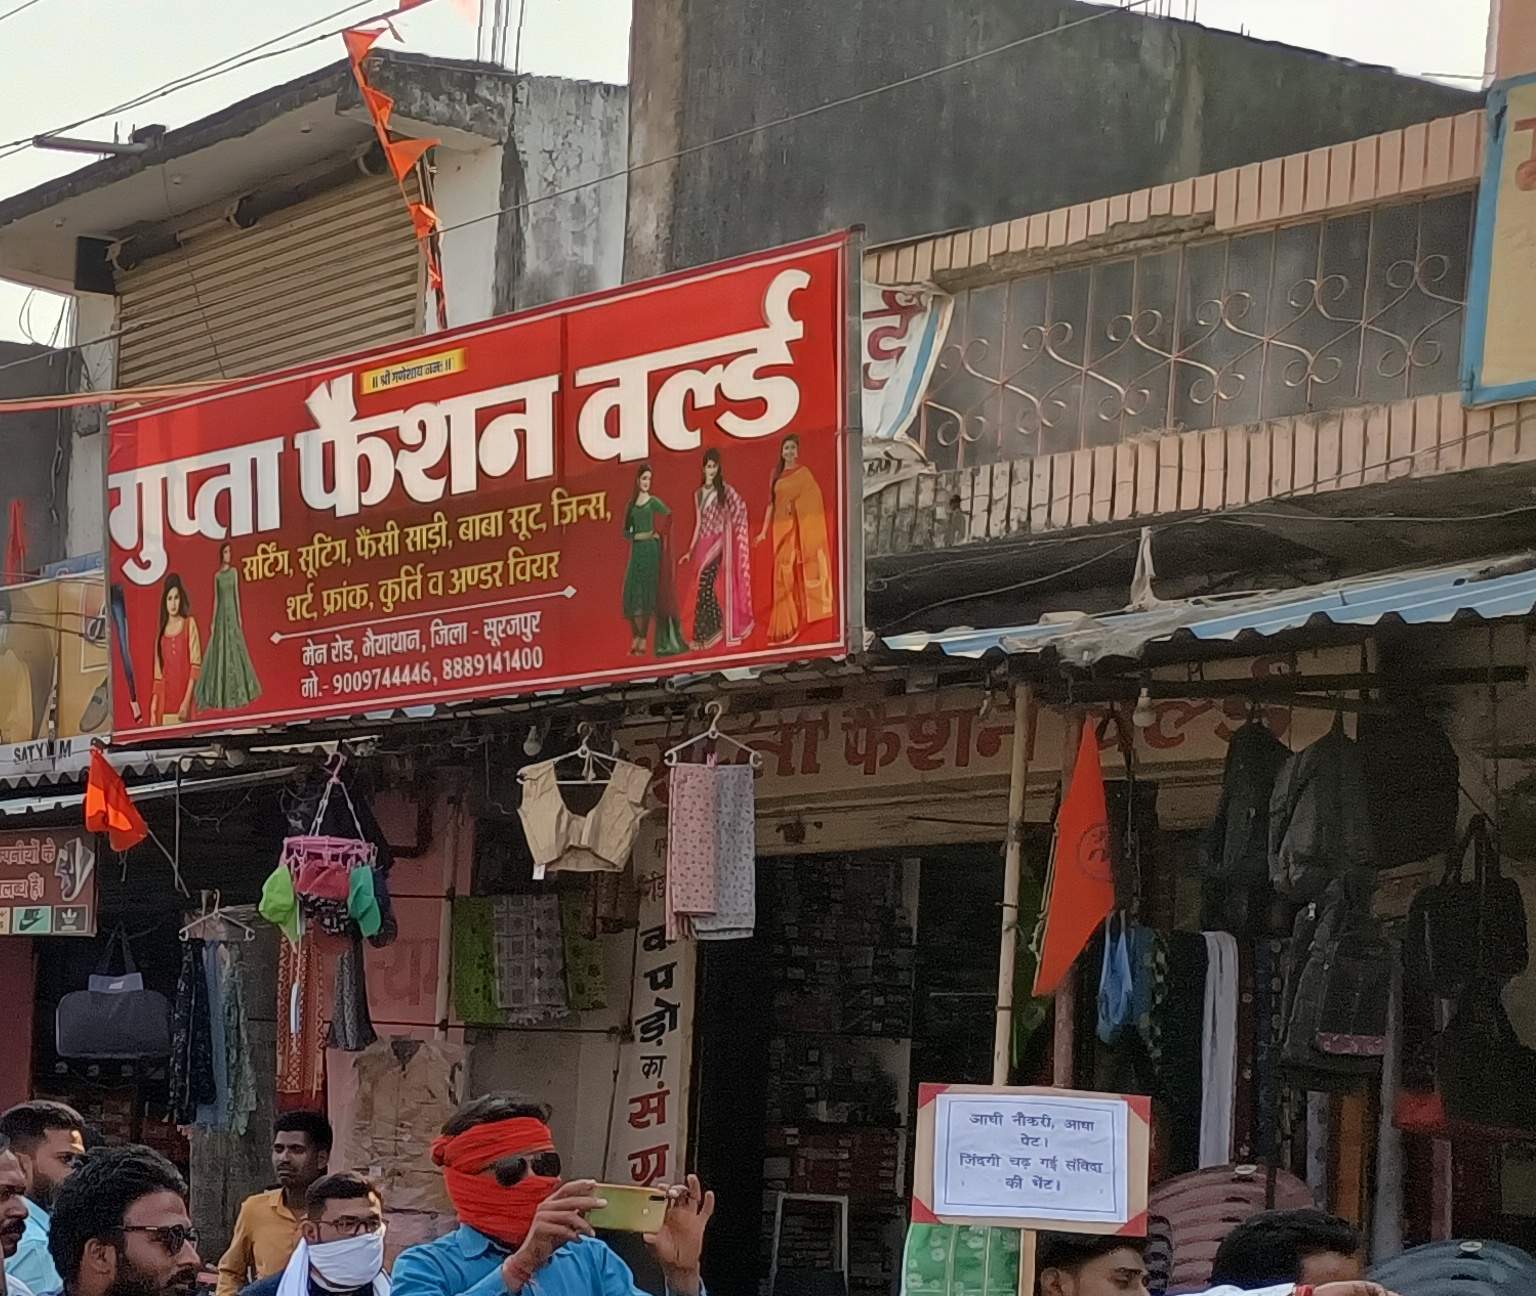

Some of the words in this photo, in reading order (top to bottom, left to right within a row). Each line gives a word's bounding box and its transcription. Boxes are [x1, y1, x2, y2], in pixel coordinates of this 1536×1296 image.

[108, 436, 285, 586] गुप्ता
[294, 372, 561, 518] फैशन
[575, 268, 812, 463] वर्ल्ड
[297, 532, 352, 579] सूटिंग,
[355, 520, 401, 560] फैंसी
[404, 510, 453, 556] साड़ी,
[457, 508, 504, 543] बाबा
[426, 572, 445, 599] व
[447, 558, 503, 596] अण्डर
[506, 547, 561, 587] वियर
[302, 637, 328, 668] मेन
[330, 632, 359, 666] रोड,
[430, 616, 468, 649] जिला
[483, 610, 542, 648] सूरजपुर
[332, 661, 438, 695] 9009744446,
[442, 646, 544, 681] 8889141400
[14, 739, 72, 764] SATYM
[41, 837, 56, 863] के
[960, 1153, 1000, 1168] जिंदगी
[1040, 1156, 1057, 1171] गई
[1066, 1158, 1103, 1174] संविदा
[1005, 1174, 1023, 1189] की
